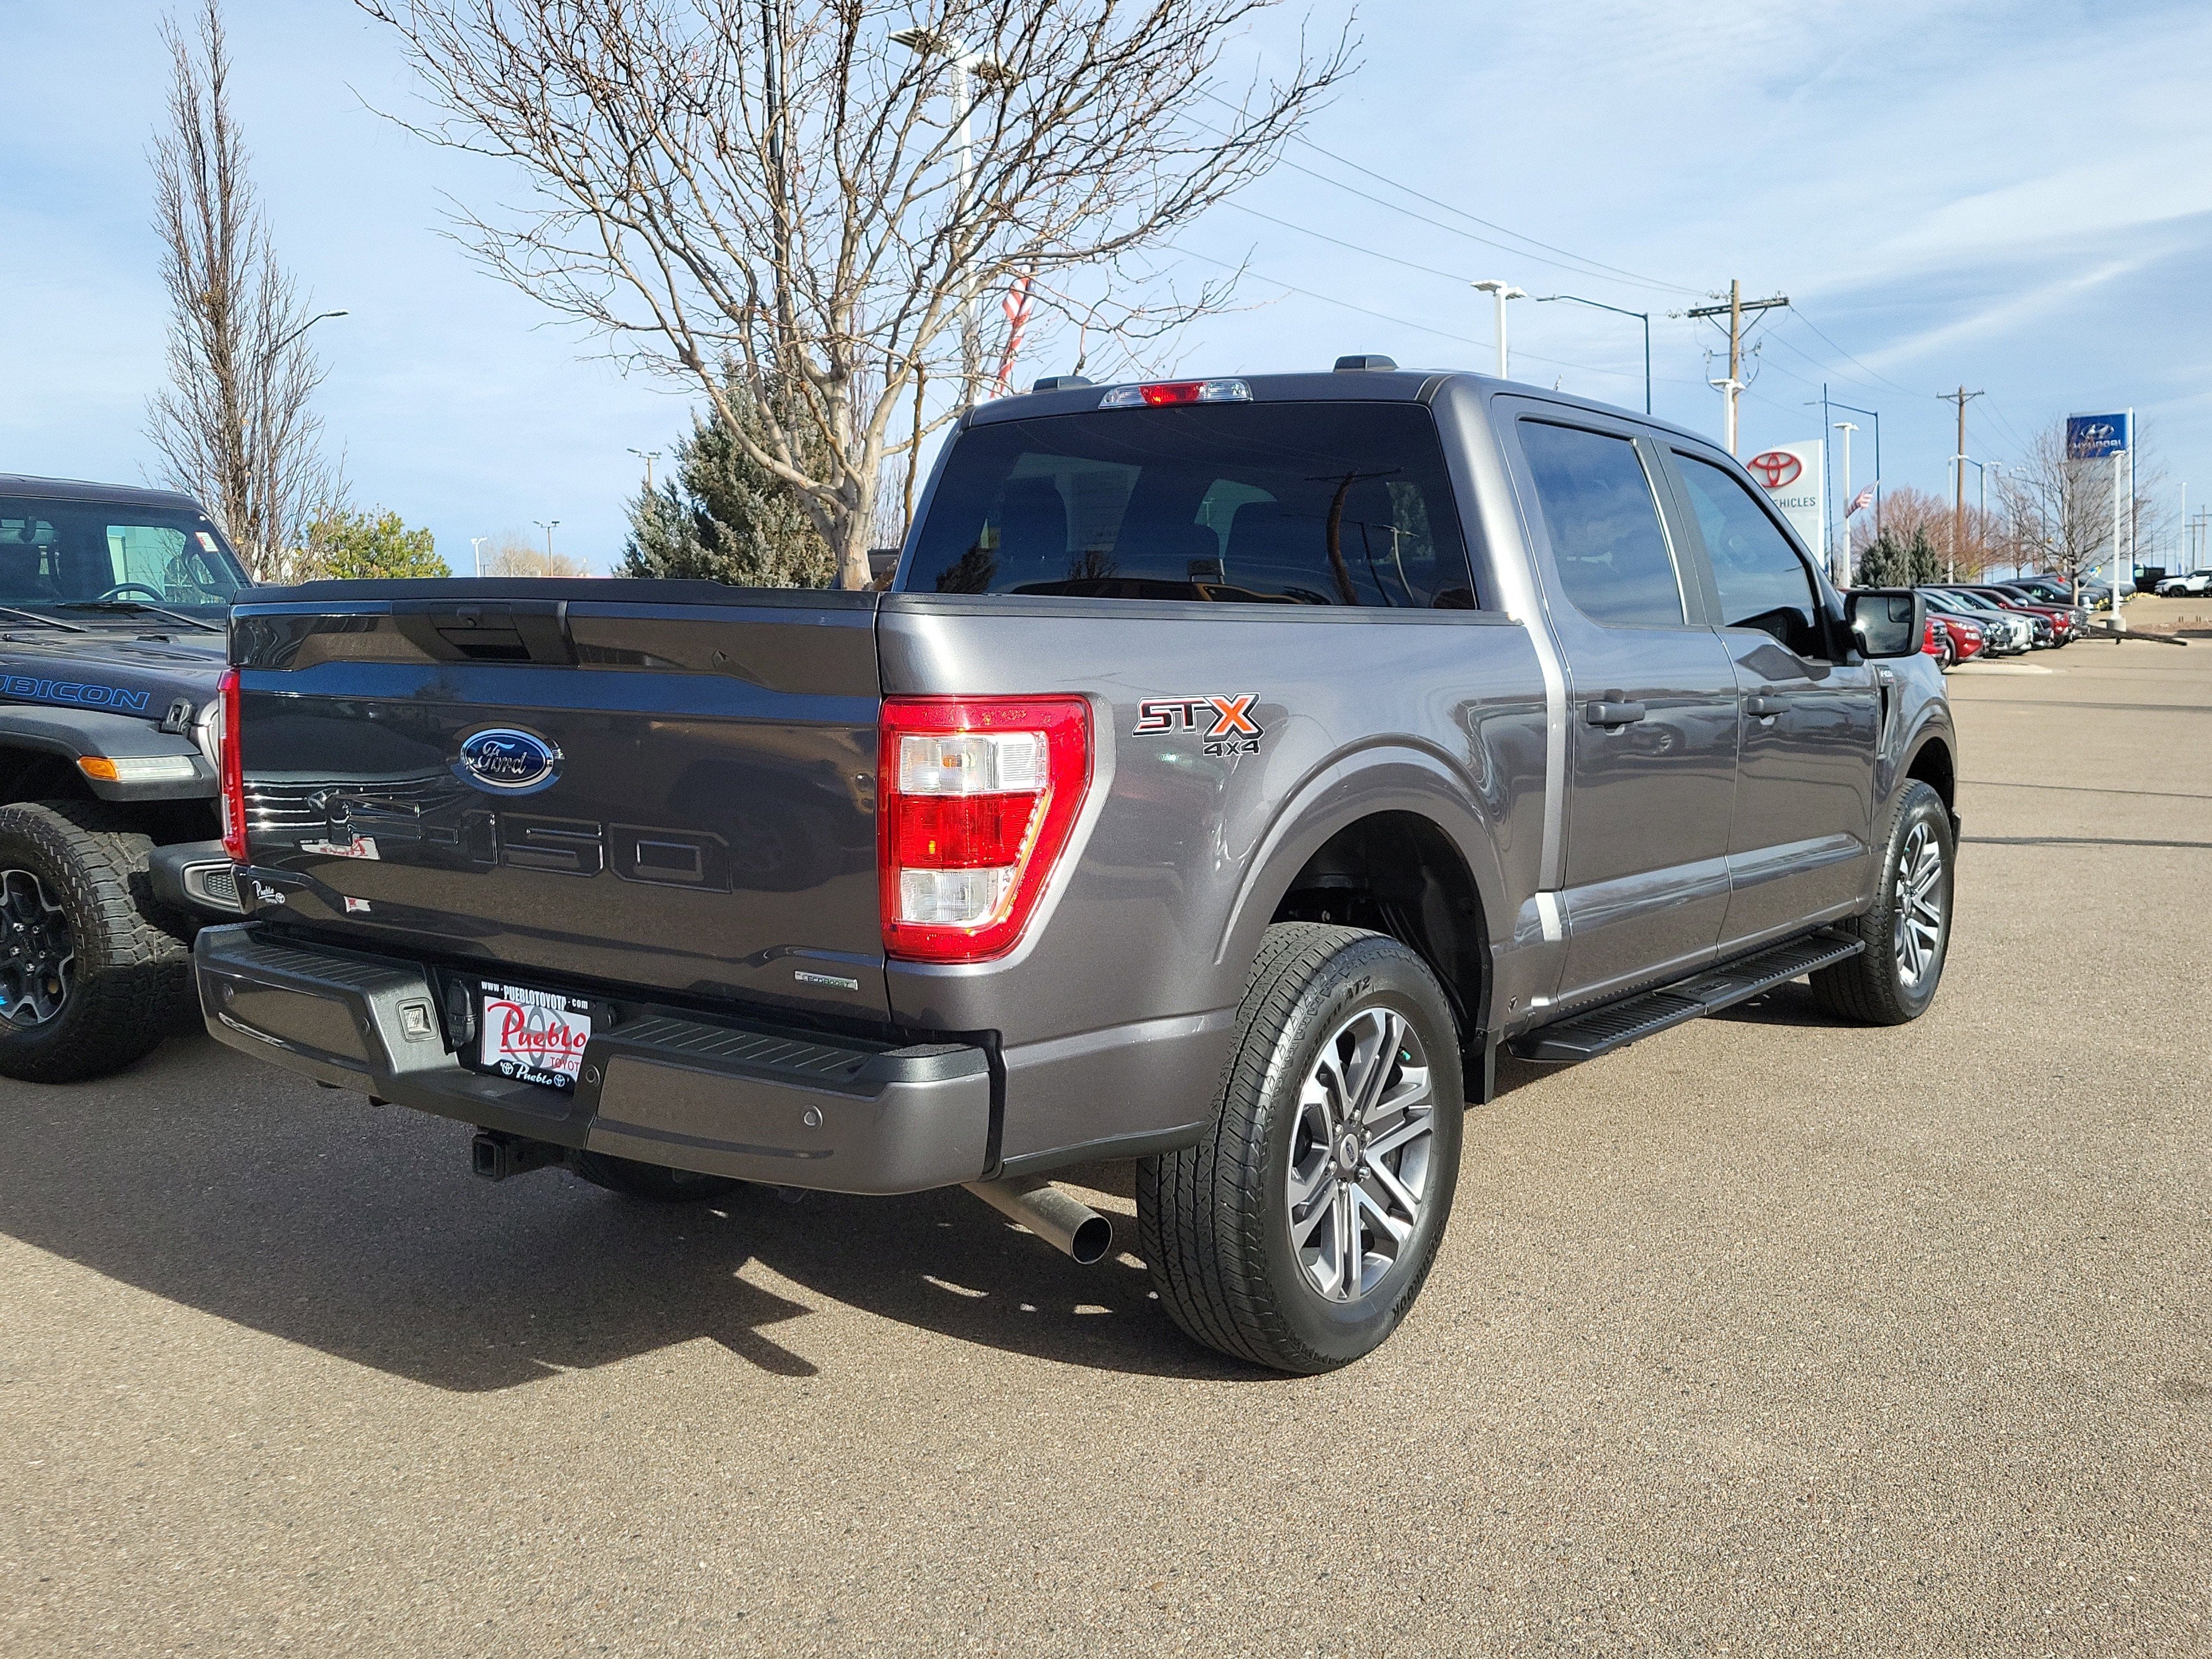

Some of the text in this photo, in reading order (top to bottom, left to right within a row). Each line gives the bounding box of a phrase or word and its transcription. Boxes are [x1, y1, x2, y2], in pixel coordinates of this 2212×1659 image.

[1773, 497, 1816, 508] HICLES
[0, 675, 150, 709] BICON
[1132, 692, 1265, 744] STX
[477, 740, 528, 774] Ford
[487, 1001, 587, 1047] Pueblo
[512, 1061, 552, 1086] Pueblo
[550, 1056, 580, 1072] TOYOT
